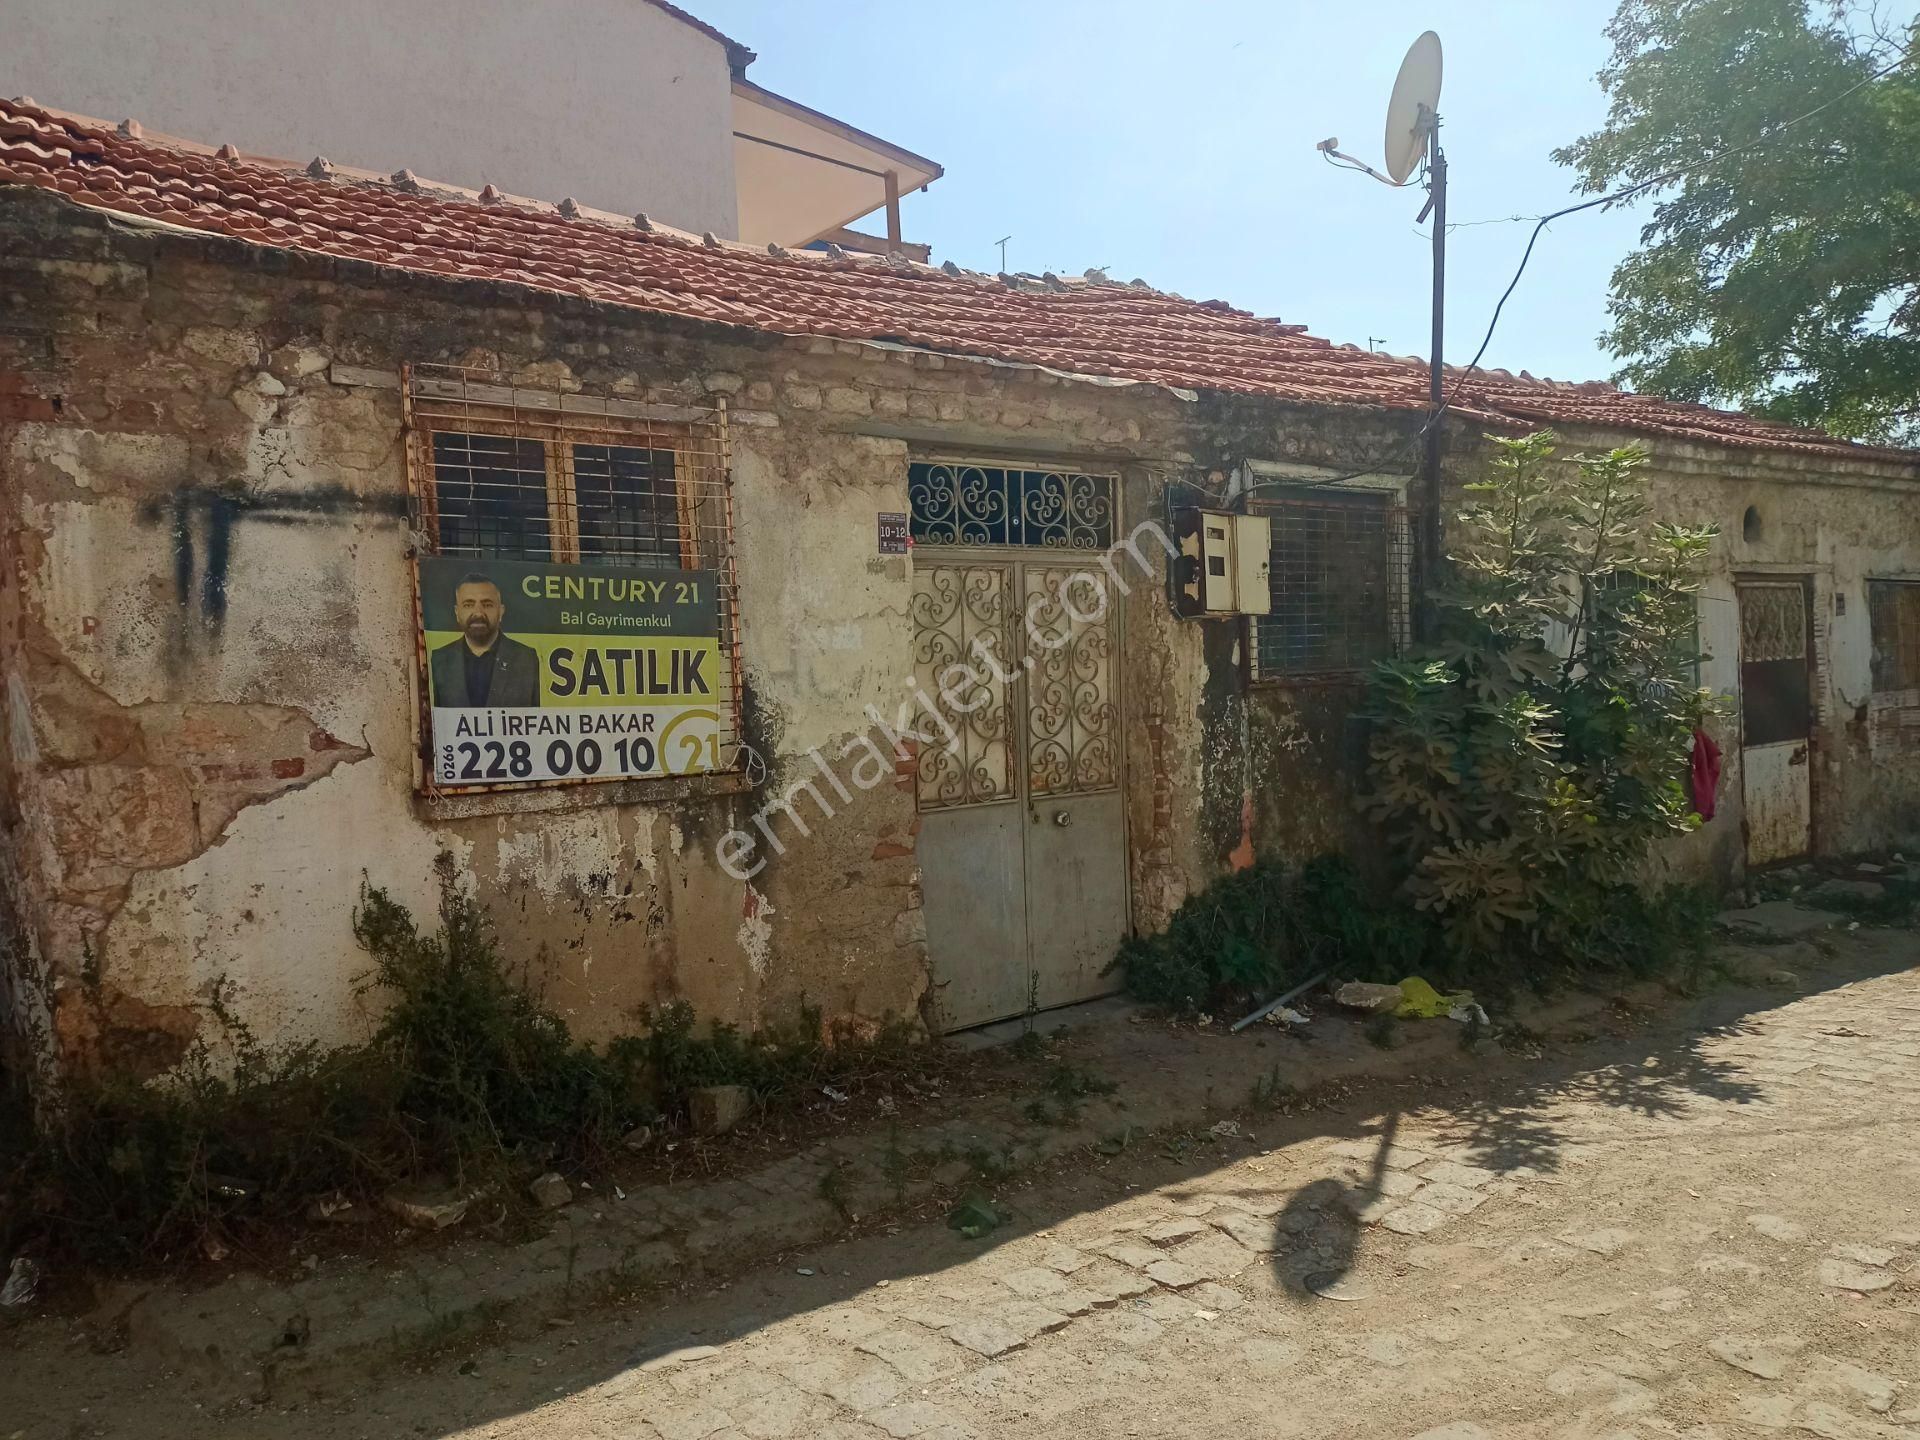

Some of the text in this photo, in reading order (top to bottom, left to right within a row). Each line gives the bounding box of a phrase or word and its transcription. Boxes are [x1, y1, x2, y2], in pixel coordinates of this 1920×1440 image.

[881, 526, 906, 538] 10-12
[521, 575, 700, 605] CENTURY 21
[561, 612, 671, 629] Bal Gayrimenkul
[548, 647, 710, 698] SATILIK
[455, 709, 655, 738] ALİ İRFAN BAKAR
[444, 744, 456, 780] 0266
[457, 736, 655, 780] 228 00 10
[679, 734, 721, 772] 21
